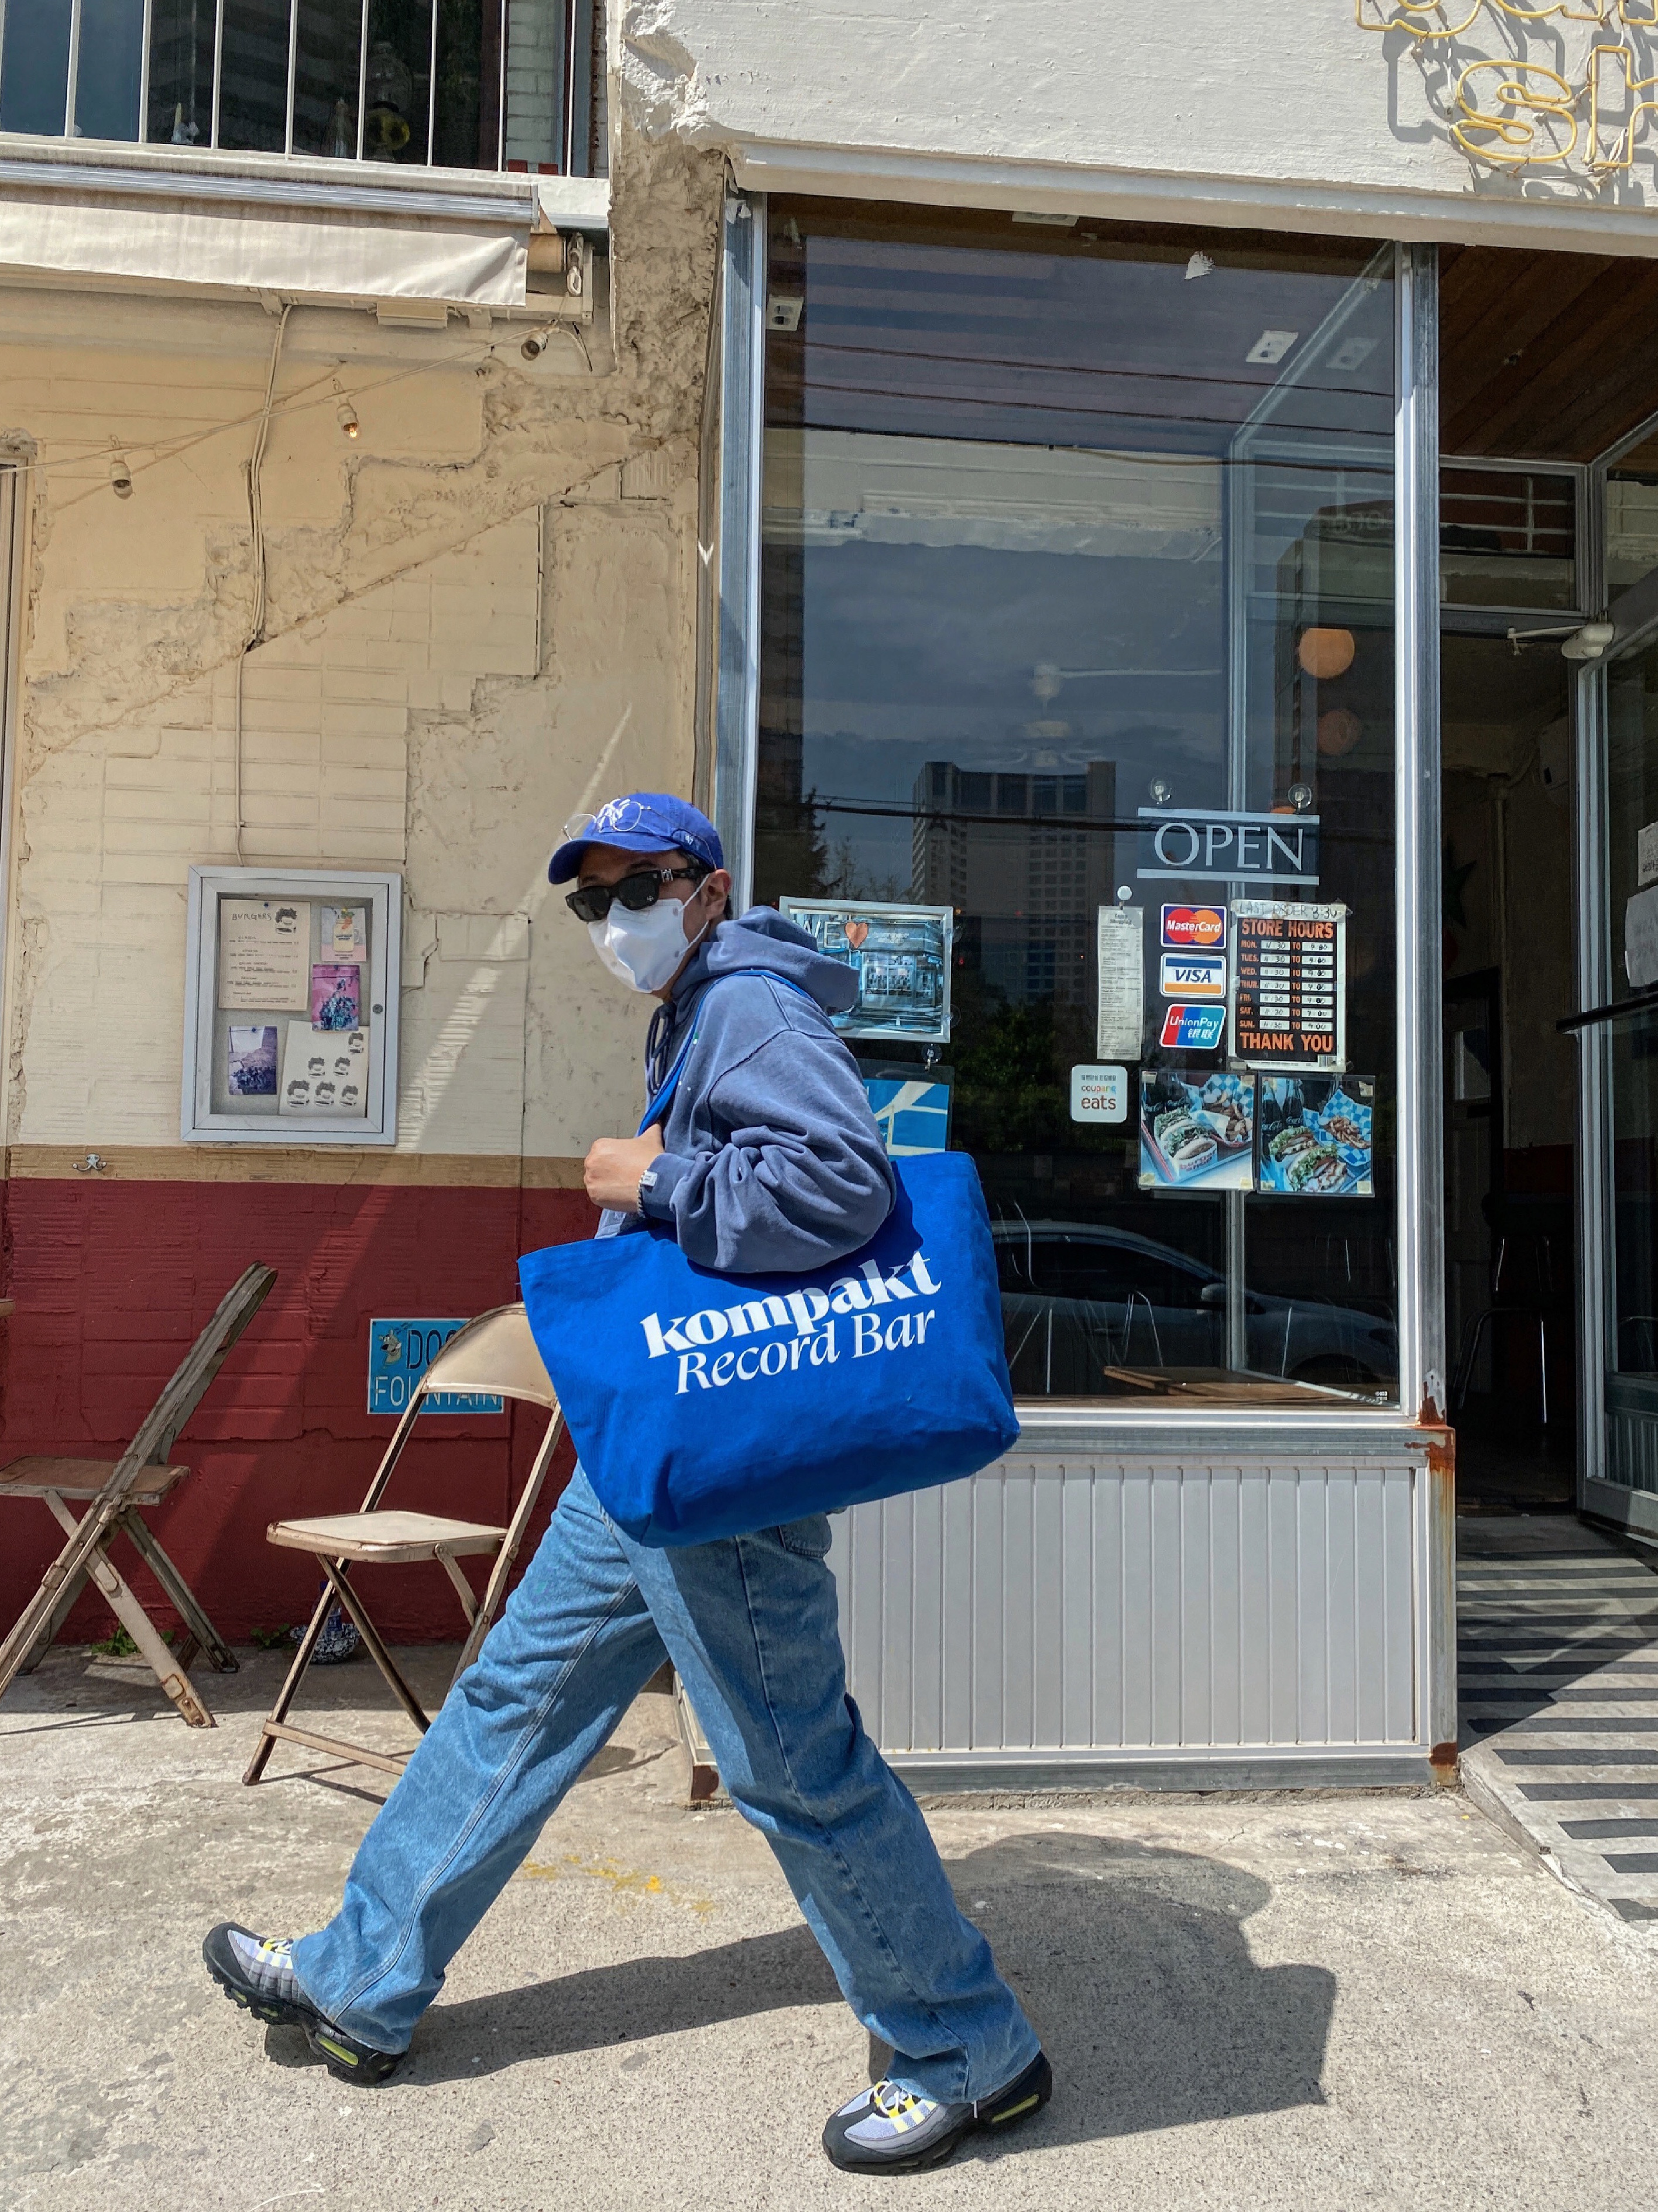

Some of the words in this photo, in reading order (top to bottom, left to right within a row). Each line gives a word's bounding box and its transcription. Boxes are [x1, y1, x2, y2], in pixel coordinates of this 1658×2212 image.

[1154, 822, 1304, 872] OPEN
[1240, 901, 1268, 915] LAST
[1273, 903, 1309, 916] ORDER
[232, 913, 272, 921] BURGERS
[1166, 919, 1221, 933] MasterCard
[1241, 918, 1283, 936] STORE
[1288, 920, 1334, 939] HOURS
[1240, 940, 1258, 949] MON.
[1292, 942, 1301, 950] TO
[1240, 953, 1259, 961] TUES.
[1173, 969, 1212, 983] VISA
[1240, 967, 1258, 976] WED.
[1240, 980, 1259, 988] THUR.
[1240, 1007, 1254, 1015] SAT.
[1170, 1015, 1219, 1032] UnionPay
[1240, 1020, 1255, 1028] SUN.
[1187, 1028, 1214, 1039] 银联
[1240, 1032, 1294, 1051] THANK
[1300, 1034, 1334, 1052] YOU
[1081, 1085, 1116, 1094] coupang
[1081, 1095, 1116, 1110] eats
[639, 1250, 941, 1359] kompakt
[406, 1329, 457, 1370] DO
[674, 1320, 841, 1396] Record
[850, 1309, 936, 1359] Bar
